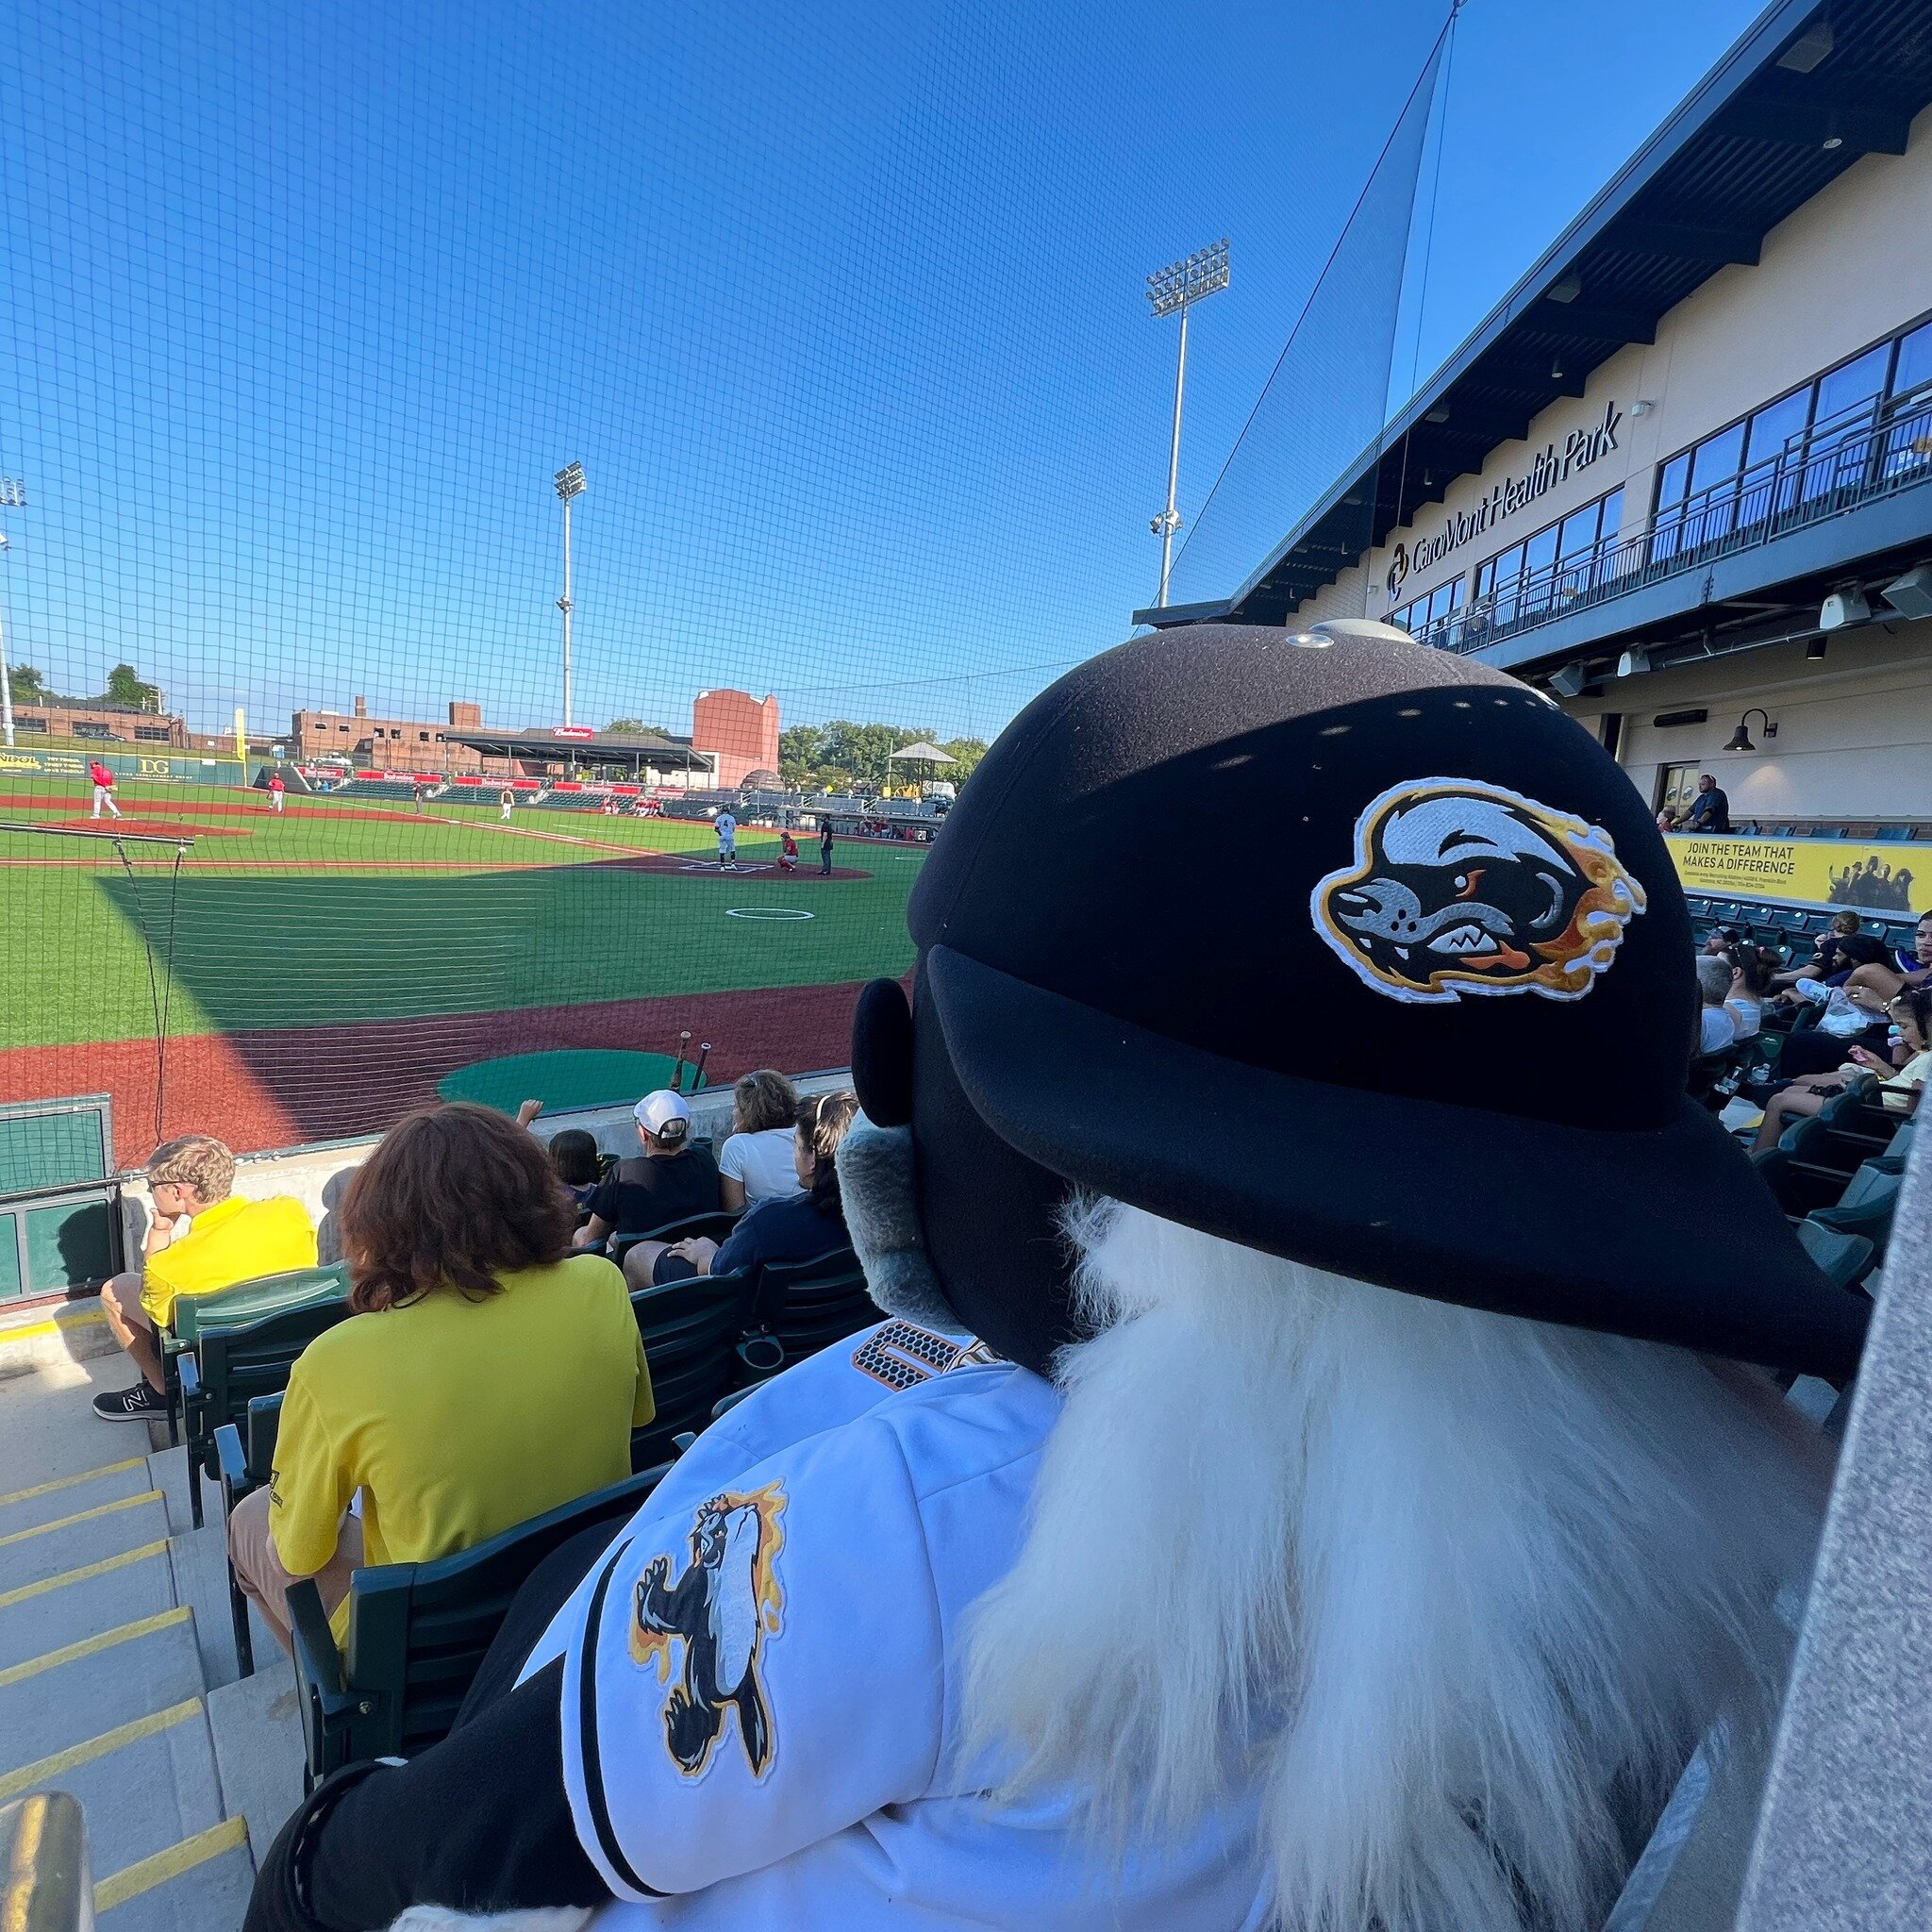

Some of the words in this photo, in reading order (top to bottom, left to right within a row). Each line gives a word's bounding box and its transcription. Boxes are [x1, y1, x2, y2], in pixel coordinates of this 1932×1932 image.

[1412, 498, 1489, 574] CaroMont
[1489, 443, 1560, 527] Health
[1559, 400, 1624, 481] Park
[140, 758, 170, 774] DG
[917, 830, 926, 841] 20
[1688, 842, 1709, 854] JOIN
[1711, 843, 1730, 856] THE
[1732, 844, 1761, 857] TEAM
[1763, 846, 1794, 859] THAT
[1683, 856, 1716, 869] MAKES
[1717, 858, 1724, 870] A
[1726, 858, 1795, 875] DIFFERENCE
